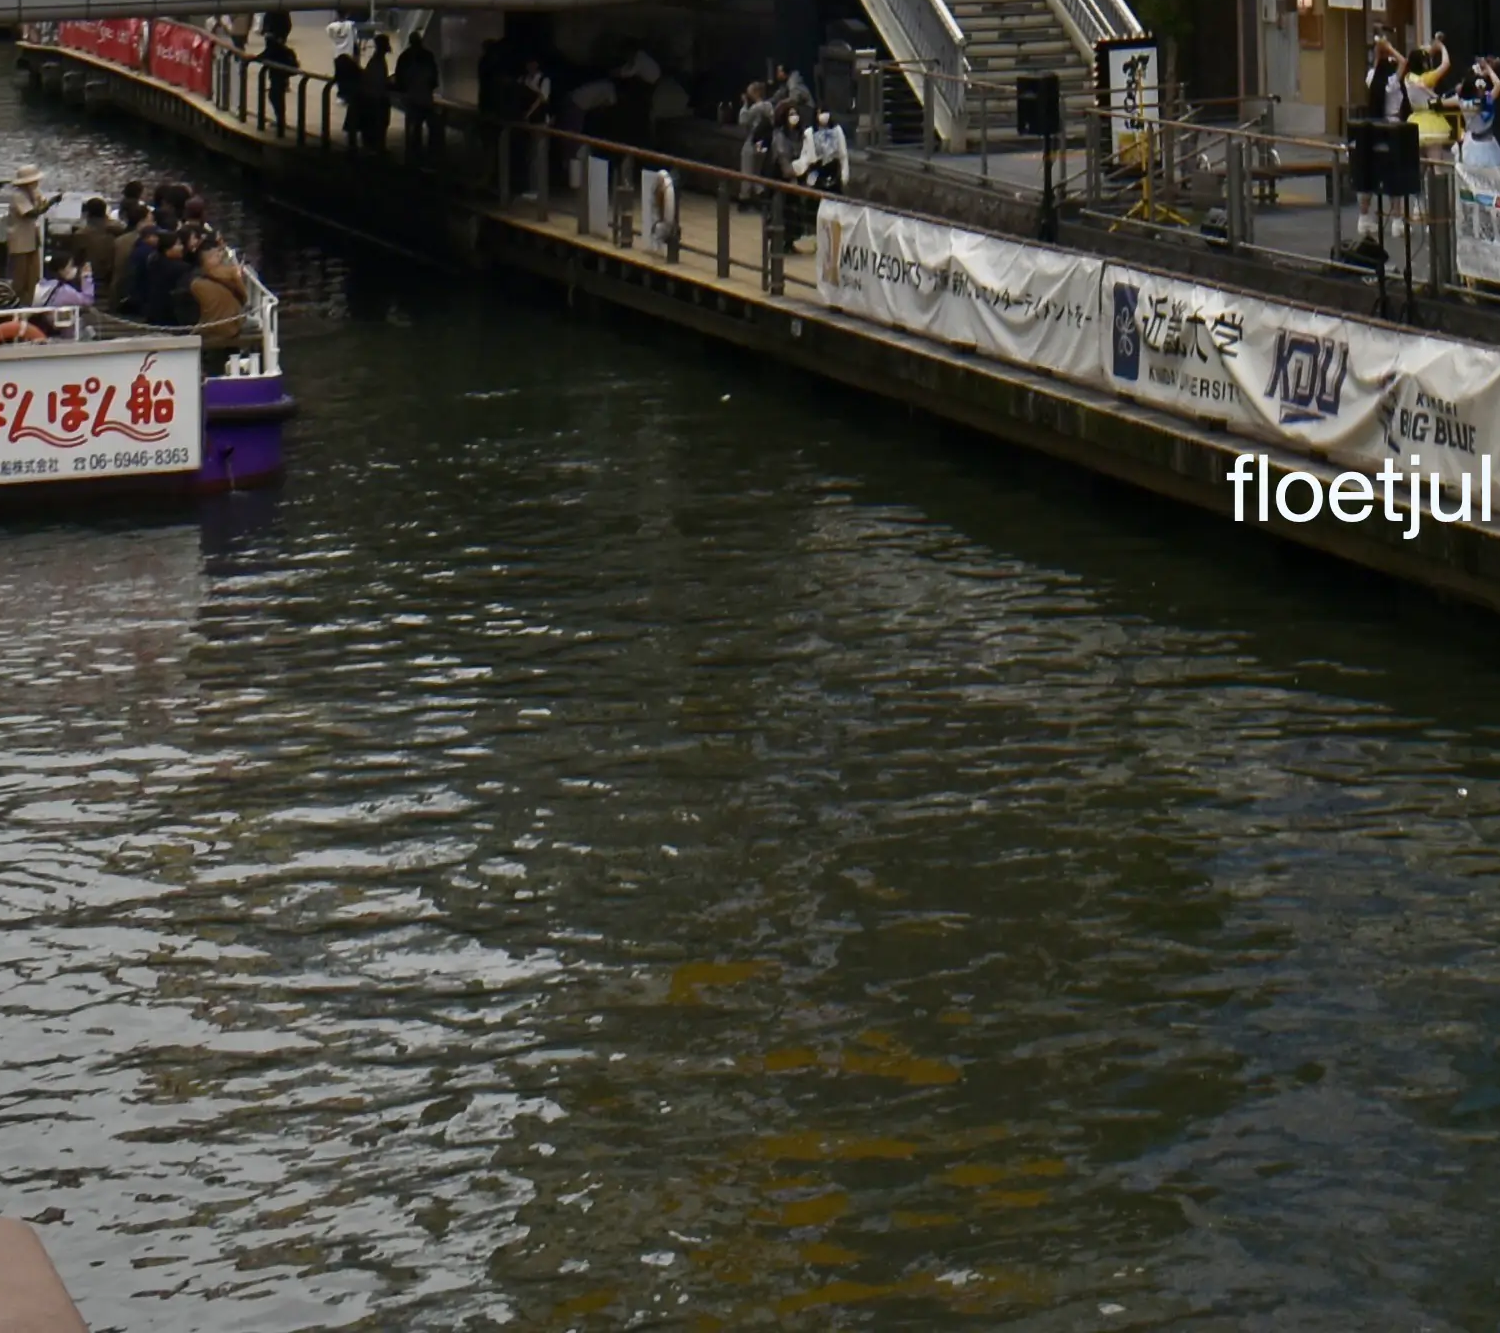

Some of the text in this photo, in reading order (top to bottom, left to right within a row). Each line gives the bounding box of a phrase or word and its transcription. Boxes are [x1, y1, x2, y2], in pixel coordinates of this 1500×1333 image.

[1142, 293, 1245, 363] 近畿大学
[1399, 408, 1476, 456] BIG BLUE
[88, 447, 190, 471] 06-6946-8363
